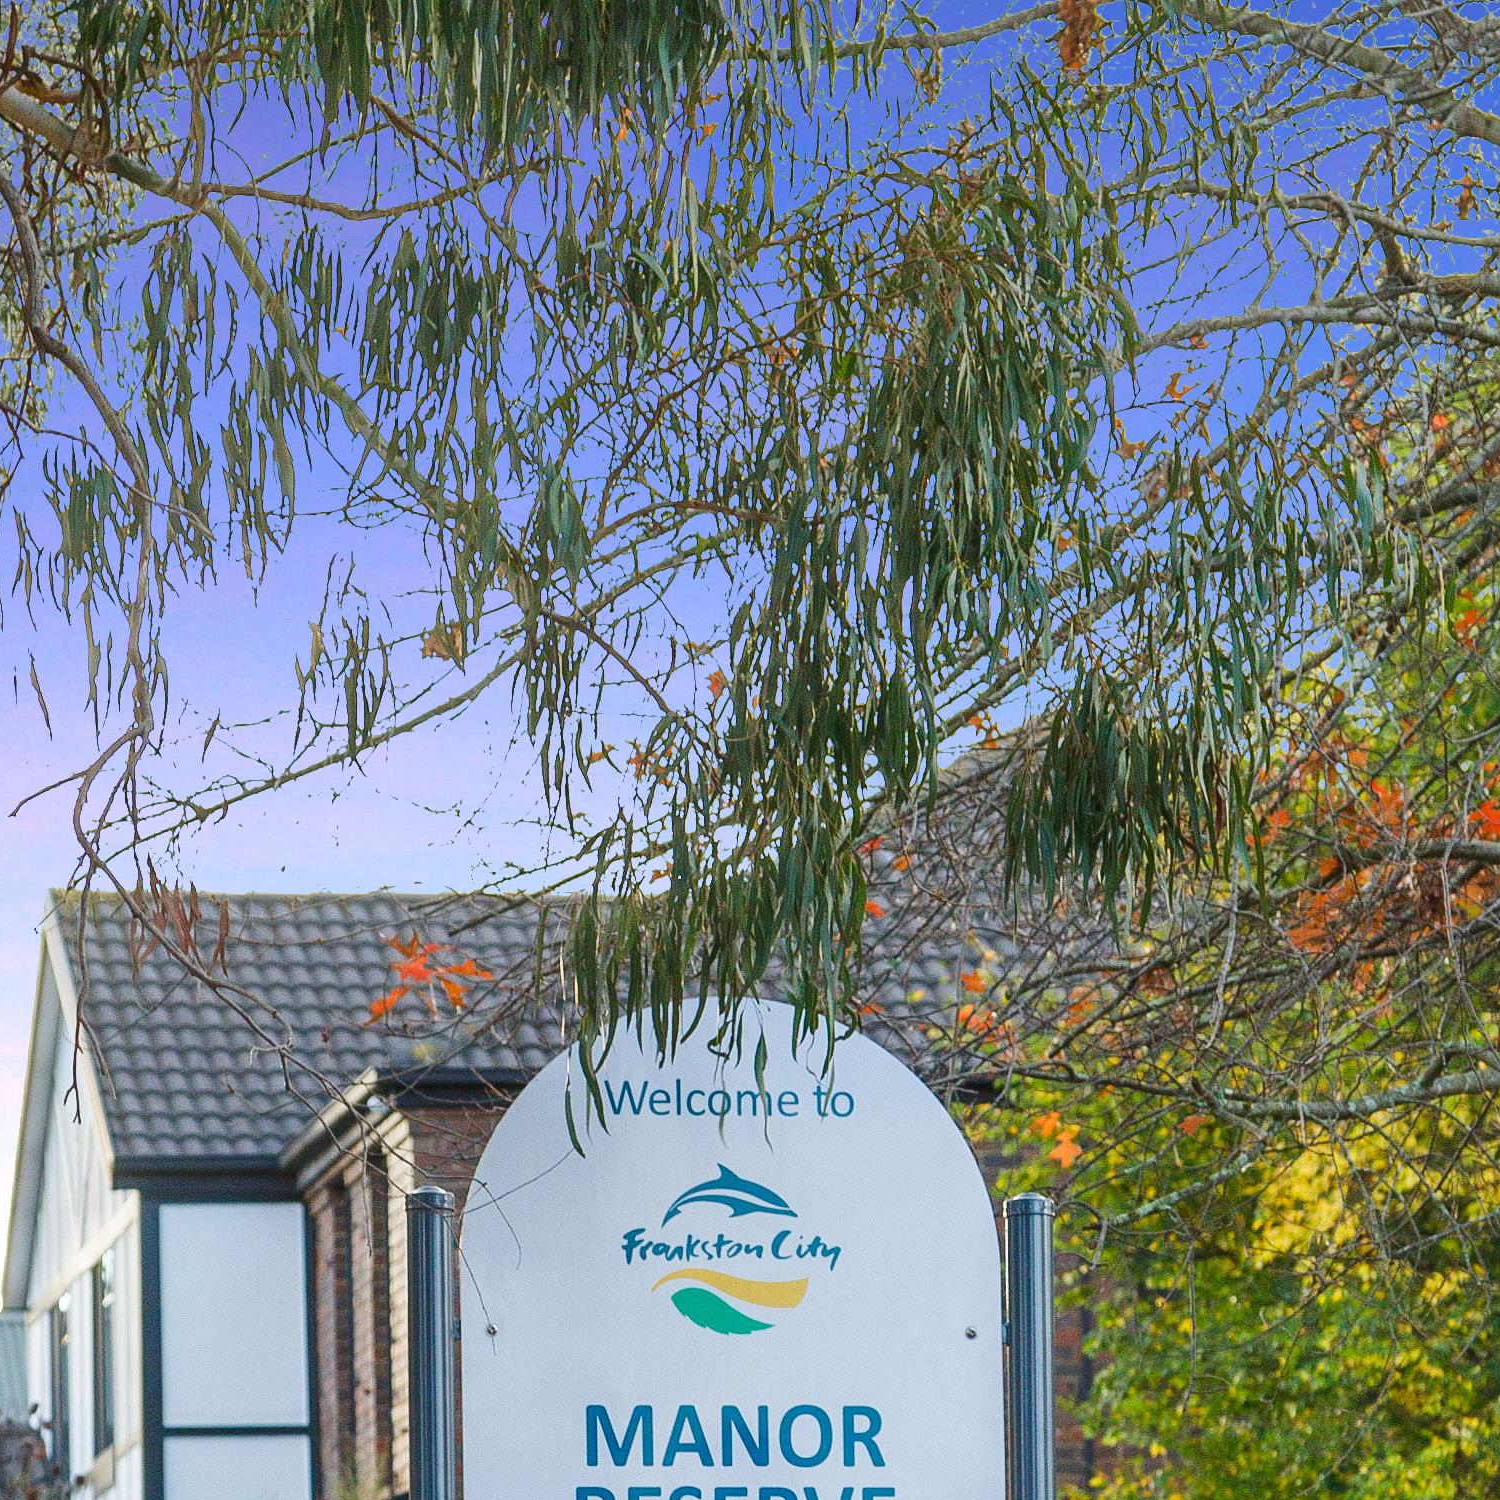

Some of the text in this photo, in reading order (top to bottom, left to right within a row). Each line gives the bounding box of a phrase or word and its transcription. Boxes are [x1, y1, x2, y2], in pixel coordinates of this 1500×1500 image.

[603, 1079, 855, 1118] Welcome to
[621, 1227, 842, 1272] Frankston City
[585, 1404, 886, 1469] MANOR
